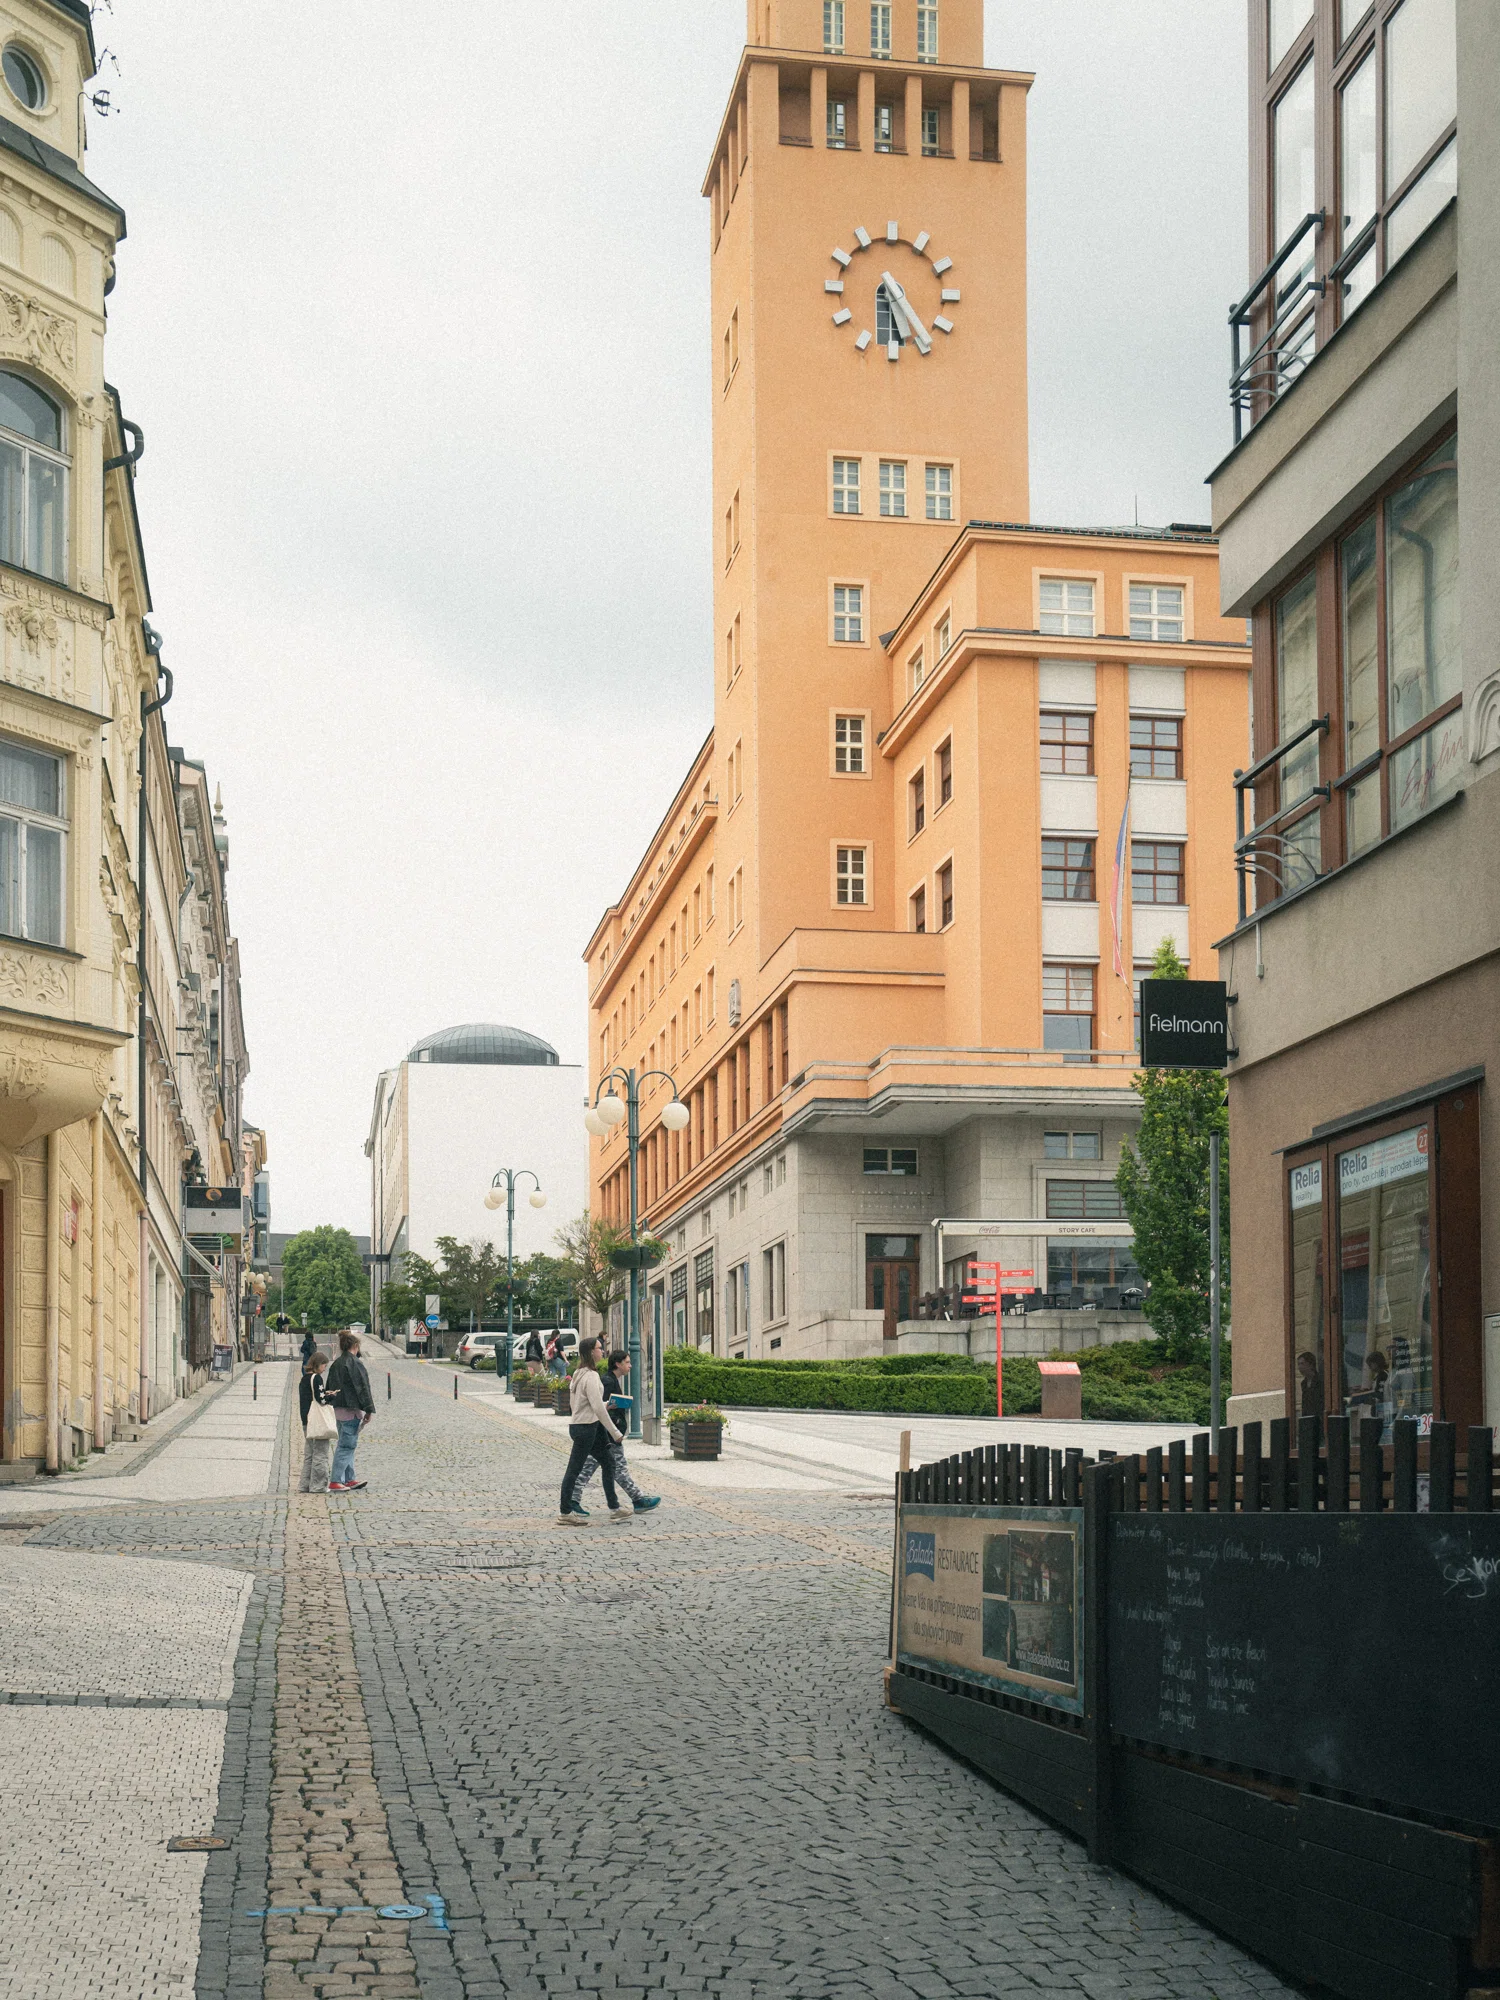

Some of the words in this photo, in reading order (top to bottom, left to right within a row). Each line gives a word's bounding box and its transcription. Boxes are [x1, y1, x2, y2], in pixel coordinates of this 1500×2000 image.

[1149, 1013, 1224, 1034] fielmann
[1341, 1152, 1368, 1178] Relia
[1295, 1166, 1320, 1191] Relia
[906, 1539, 934, 1567] Balada
[937, 1548, 979, 1574] RESTAURACE
[956, 1602, 981, 1623] posezení
